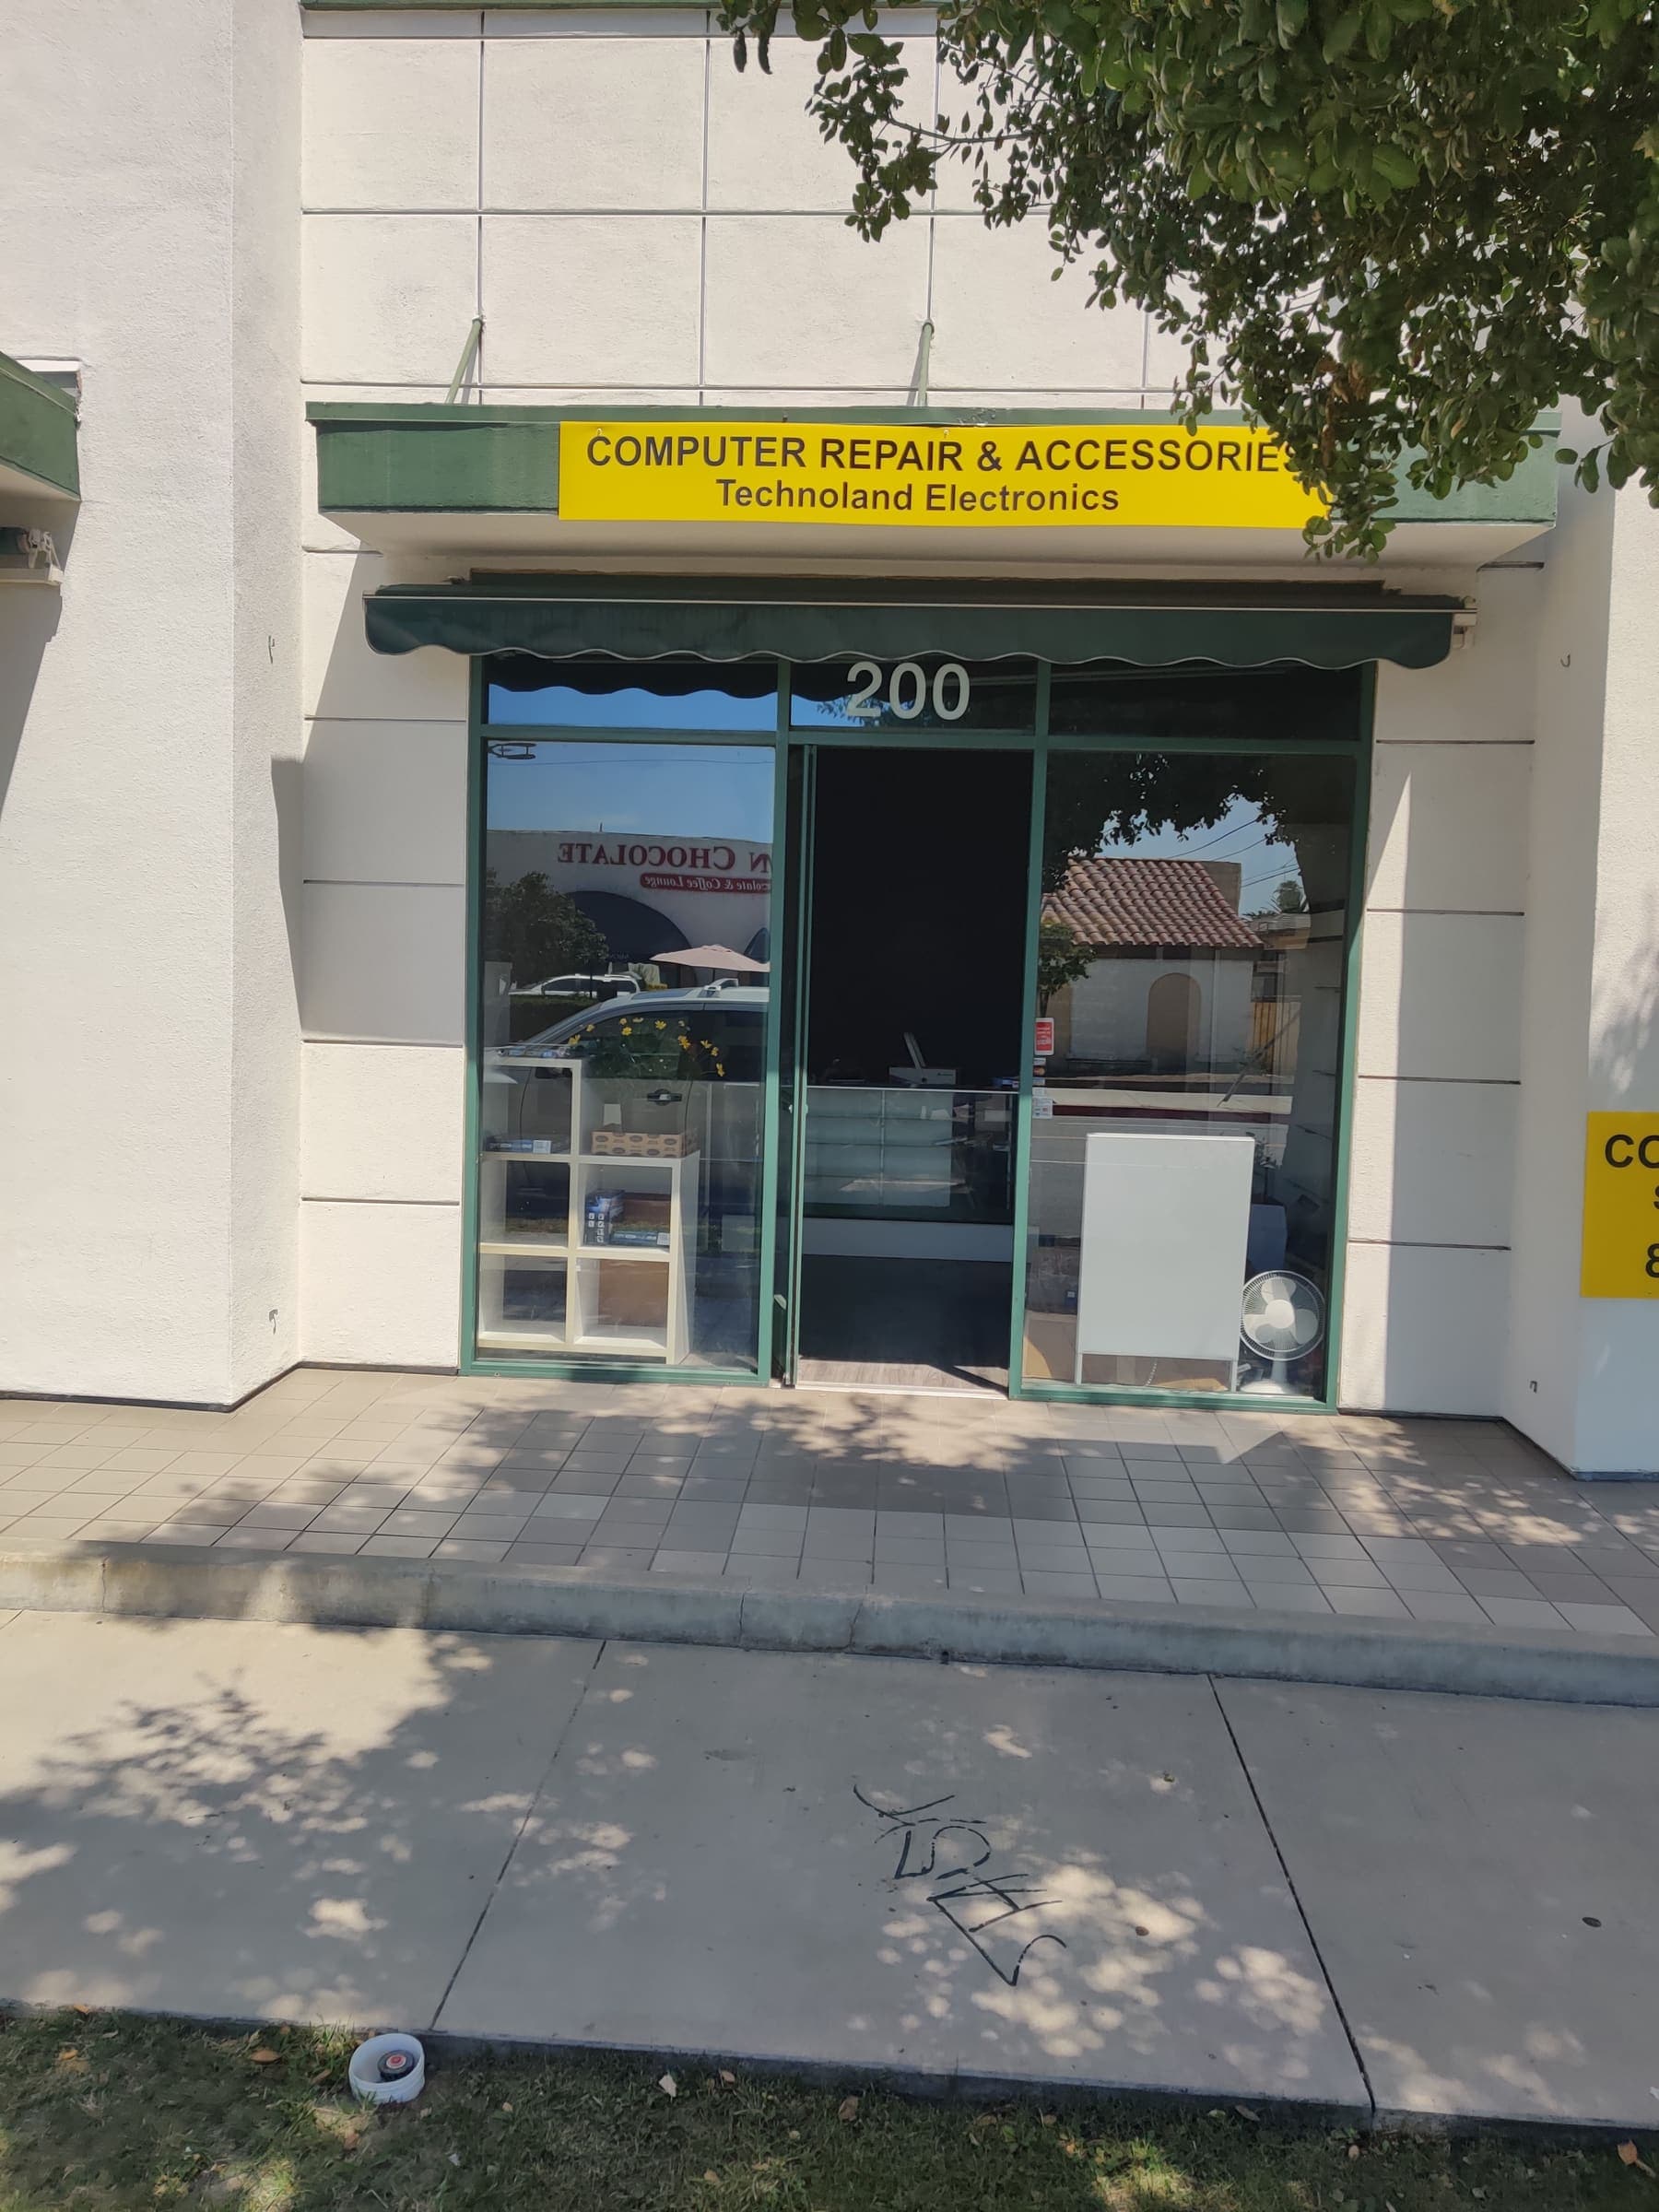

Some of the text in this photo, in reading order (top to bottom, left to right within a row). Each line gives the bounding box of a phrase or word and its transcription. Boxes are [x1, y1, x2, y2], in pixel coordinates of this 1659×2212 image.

[587, 435, 806, 467] COMPUTER
[820, 438, 963, 471] REPAIR
[977, 441, 1003, 471] &
[716, 478, 1119, 512] Technoland Electronics
[845, 661, 971, 721] 200
